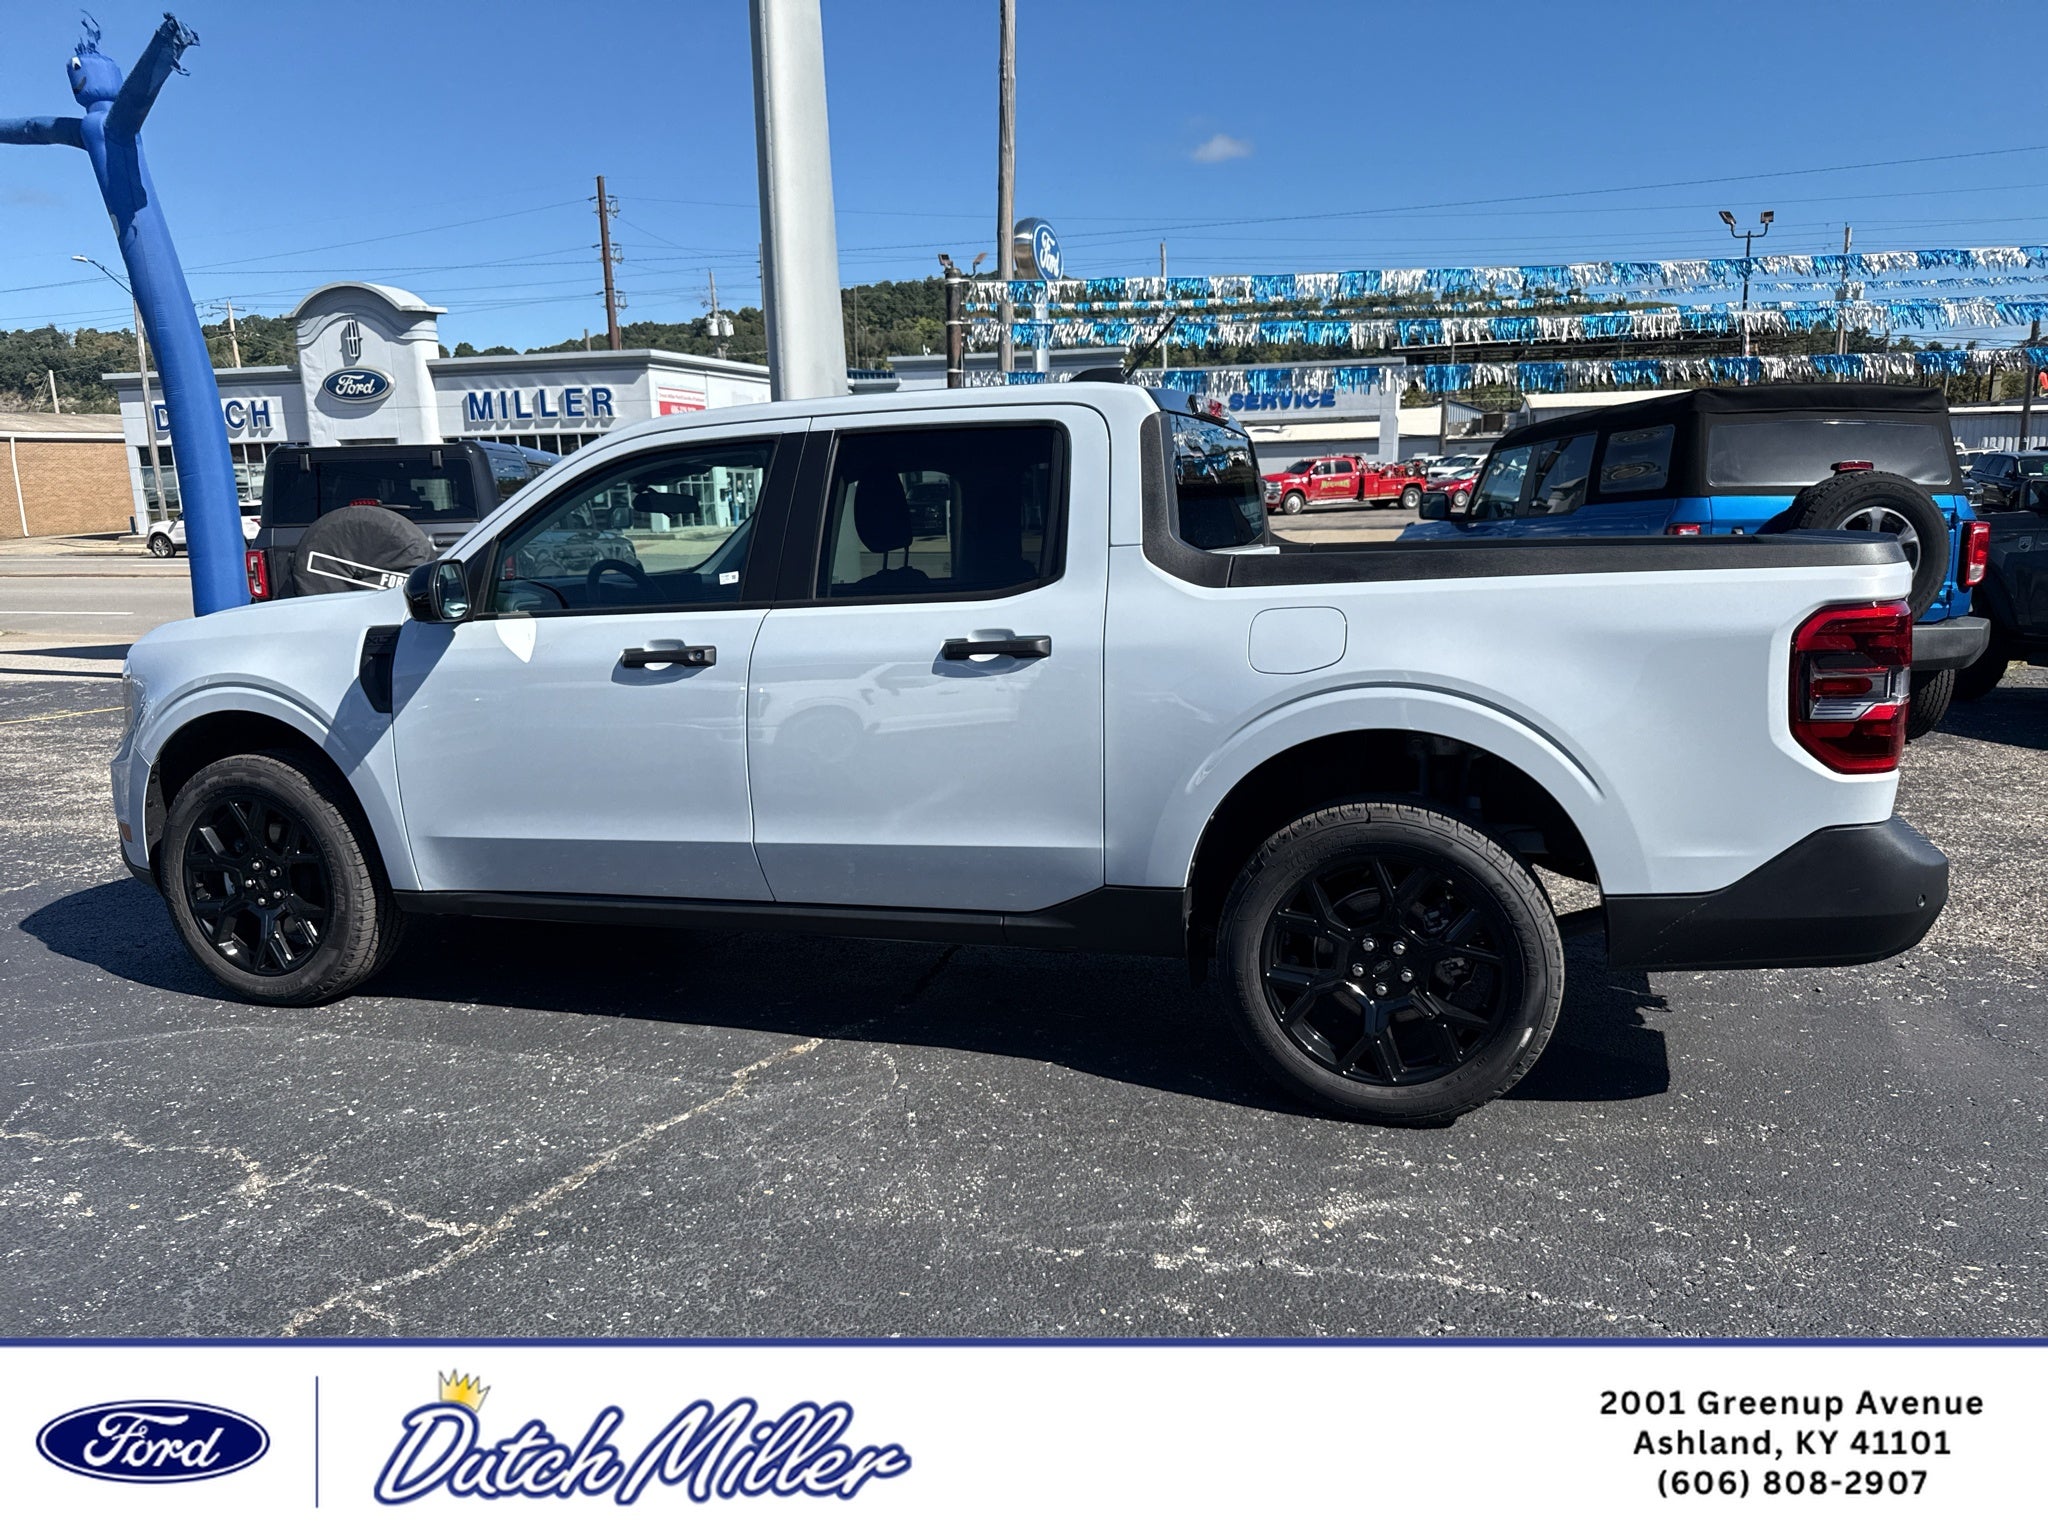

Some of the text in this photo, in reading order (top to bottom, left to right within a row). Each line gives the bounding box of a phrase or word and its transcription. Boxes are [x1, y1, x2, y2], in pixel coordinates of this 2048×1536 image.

[1040, 231, 1060, 278] Ford
[335, 374, 376, 395] Ford
[467, 386, 615, 421] MILLER
[1228, 388, 1336, 412] SERVICE
[154, 400, 272, 431] DCH
[380, 573, 408, 589] FOR
